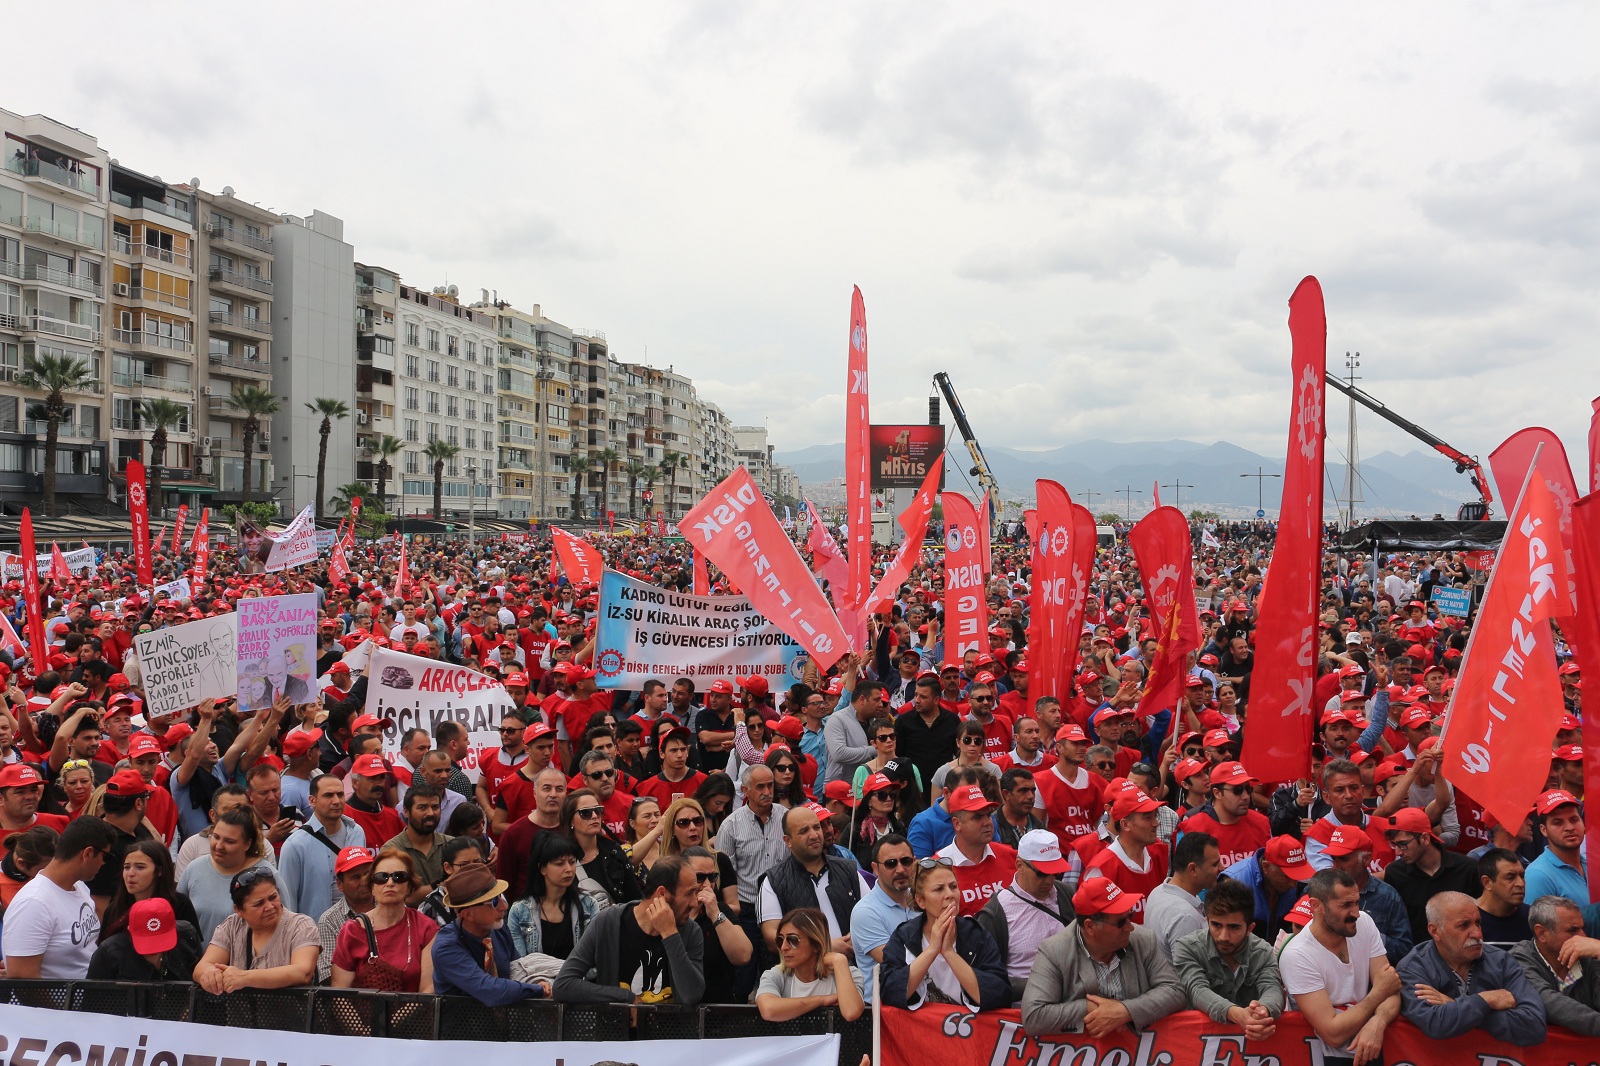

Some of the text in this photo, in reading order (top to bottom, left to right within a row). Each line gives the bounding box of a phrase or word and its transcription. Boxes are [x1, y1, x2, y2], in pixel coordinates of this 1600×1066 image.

[881, 457, 925, 475] MAYIS
[135, 512, 146, 569] DİSK
[621, 587, 665, 604] KADRO
[240, 599, 280, 613] TUNÇ
[241, 608, 317, 628] BAŞKANIM
[607, 603, 774, 632] İZ-SU KİRALIK ARAÇ ŞOF
[238, 624, 316, 644] KİRALIK ŞOFÖRLER
[635, 628, 658, 647] İŞ
[662, 631, 728, 648] GÜVENCESİ
[140, 633, 181, 656] İZMİR
[238, 641, 271, 654] KADRO
[603, 658, 629, 666] DİSK
[626, 661, 787, 676] DİSK GENEL-İŞ İZMİR 2 NO'LU ŞUBE
[148, 678, 195, 701] KADRO İLE
[151, 691, 196, 714] GÜZEL
[1220, 850, 1254, 867] DİSK
[962, 880, 1004, 903] DİSK
